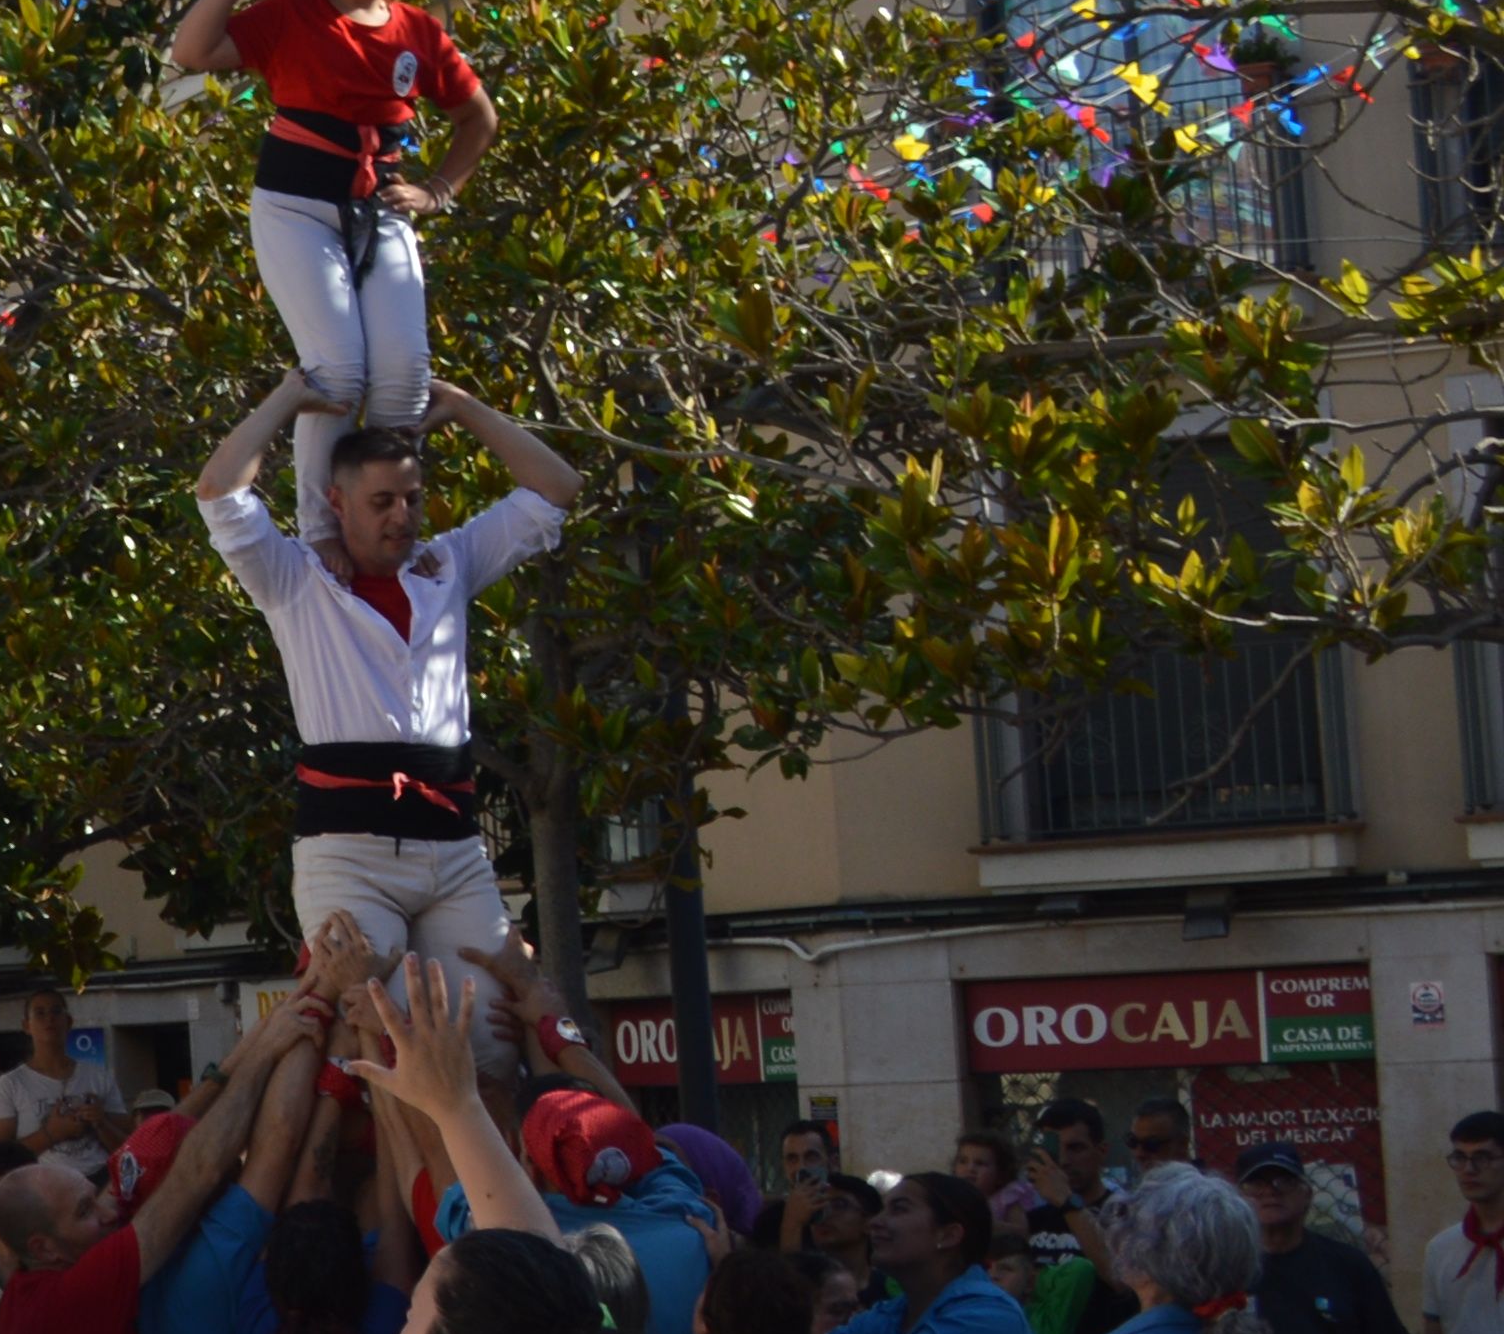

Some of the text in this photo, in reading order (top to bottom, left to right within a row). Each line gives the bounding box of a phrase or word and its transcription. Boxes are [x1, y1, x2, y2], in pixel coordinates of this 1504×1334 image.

[1270, 976, 1370, 995] COMPREM
[1305, 993, 1336, 1008] OR
[973, 999, 1252, 1049] OROCAJA
[1282, 1026, 1364, 1043] CASA DE
[616, 1017, 752, 1072] OROJA
[1200, 1113, 1224, 1129] LA
[1228, 1110, 1297, 1127] MAJOR
[1275, 1126, 1355, 1144] MERCAT
